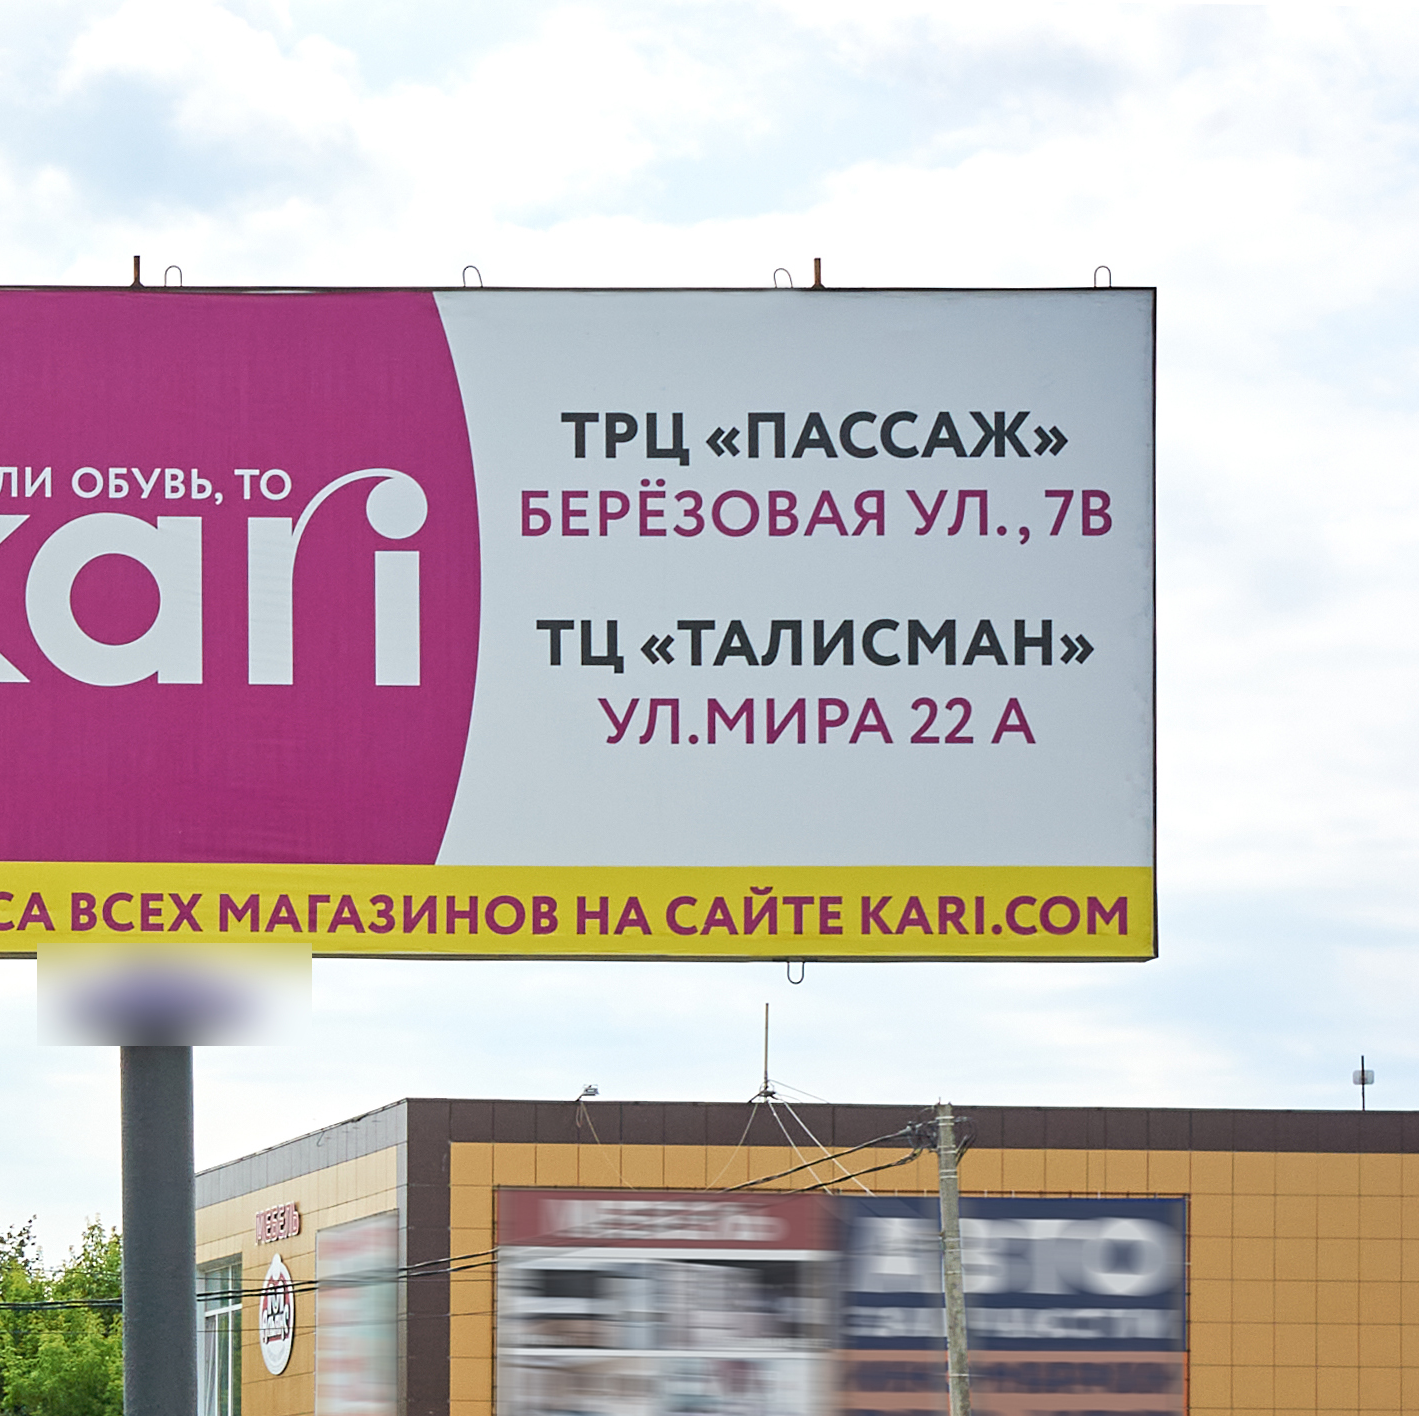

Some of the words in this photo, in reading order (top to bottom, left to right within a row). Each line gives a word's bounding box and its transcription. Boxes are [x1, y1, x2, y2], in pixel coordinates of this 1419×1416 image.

[561, 411, 690, 467] ТРЦ
[706, 411, 1069, 459] «ПАССАЖ»
[71, 466, 224, 505] ОБУВЬ,
[233, 468, 292, 501] ТО
[521, 478, 886, 538] БЕРЁЗОВАЯ
[905, 490, 1031, 546] УЛ.,
[1044, 490, 1113, 537] 7В
[535, 619, 625, 674] ТЦ
[641, 619, 1095, 667] «ТАЛИСМАН»
[597, 697, 894, 745] УЛ.МИРА
[911, 697, 975, 745] 22
[990, 697, 1037, 745] А
[70, 892, 203, 932] ВСЕХ
[219, 893, 559, 935] МАГАЗИНОВ
[576, 896, 653, 936] НА
[665, 886, 844, 936] САЙТЕ
[861, 896, 1128, 936] KARI.COM
[255, 1201, 300, 1245] МЕБЕЛЬ
